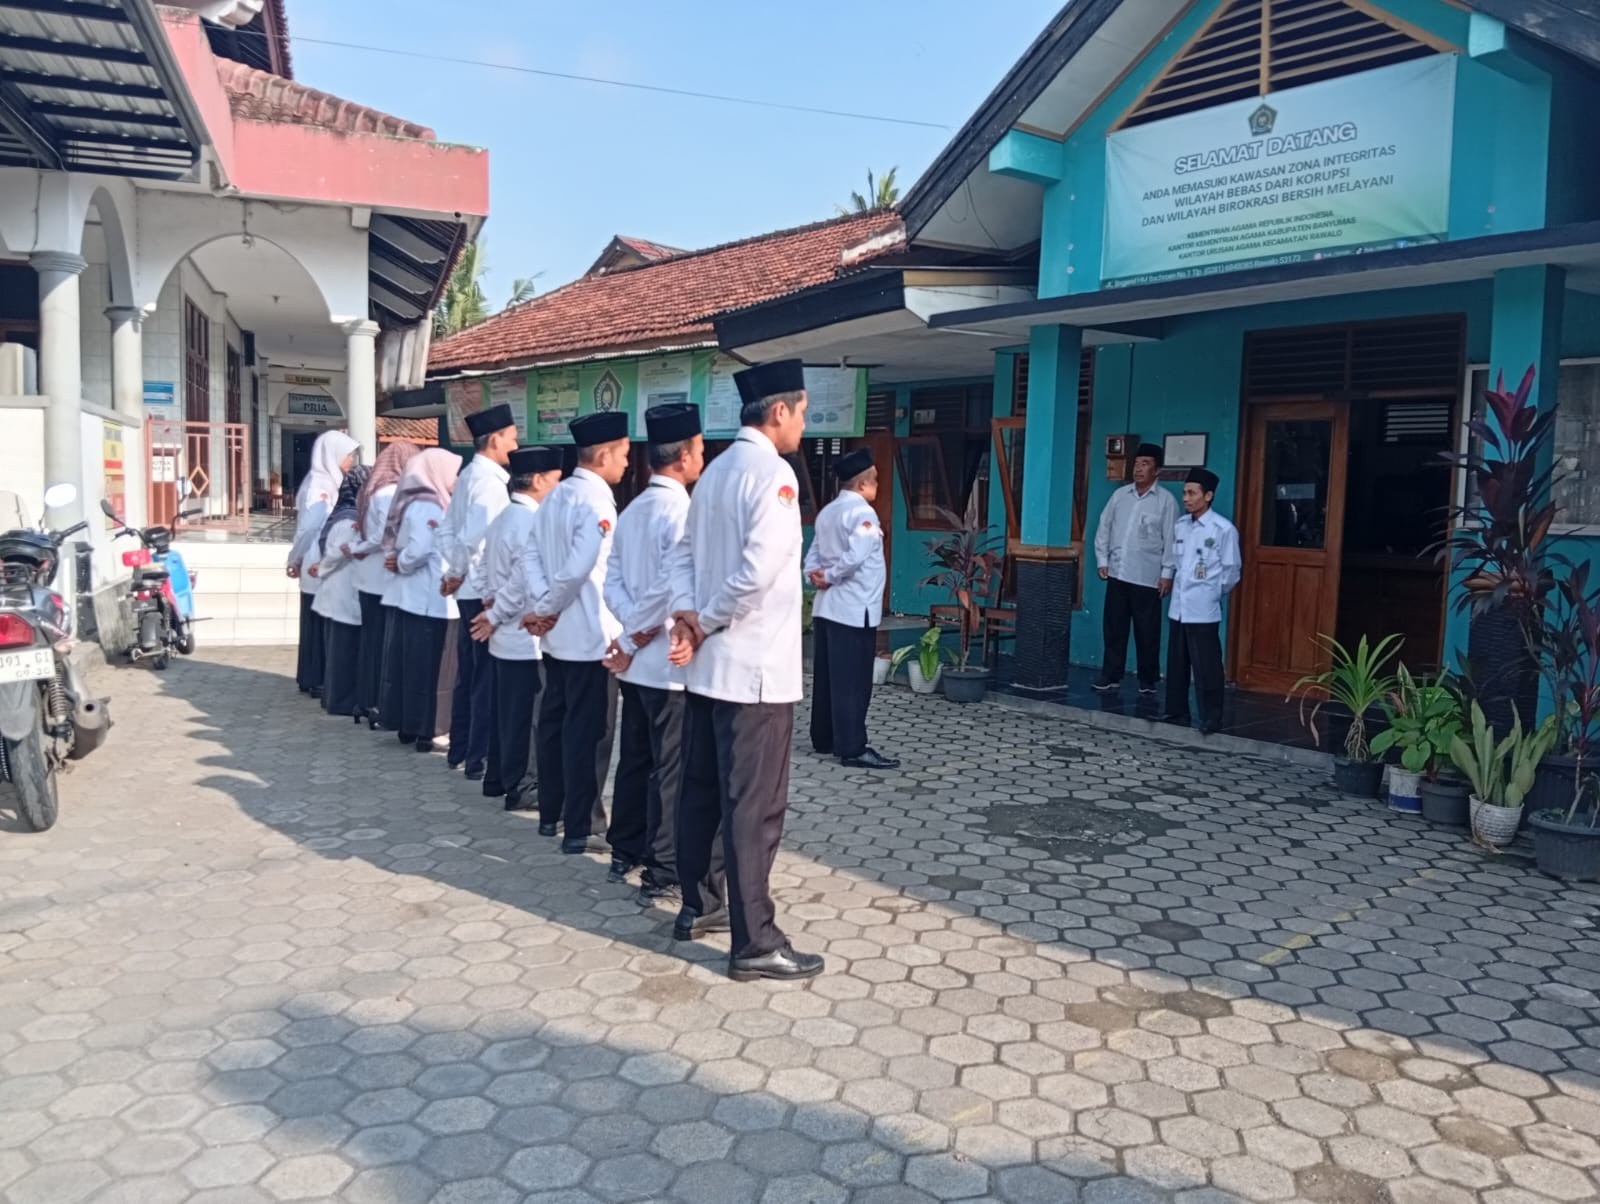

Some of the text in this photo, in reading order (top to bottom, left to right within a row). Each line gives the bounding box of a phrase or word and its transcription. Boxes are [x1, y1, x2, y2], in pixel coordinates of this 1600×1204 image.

[1174, 121, 1358, 175] SELAMAT DATANG
[1142, 144, 1397, 202] ANDA MEMASUKI KAWASAN ZONA INTEGRITAS
[1174, 166, 1351, 208] WILAYAH BEBAS DARI KORUPSI
[1141, 174, 1394, 228] DAN WILAYAH BIROKRASI BERSIH MELAYANI
[1167, 241, 1195, 252] KANTOR
[1239, 230, 1267, 242] AGAMA
[1267, 223, 1312, 237] KABUPATEN
[1312, 216, 1357, 231] BANYUMAS
[1178, 228, 1344, 260] KANTOR URUSAN AGAMA KECAMATAN RAWALO
[1186, 209, 1335, 240] KEMENTRIAN AGAMA REPUBLIK INDONESIA
[303, 402, 328, 413] PRIA
